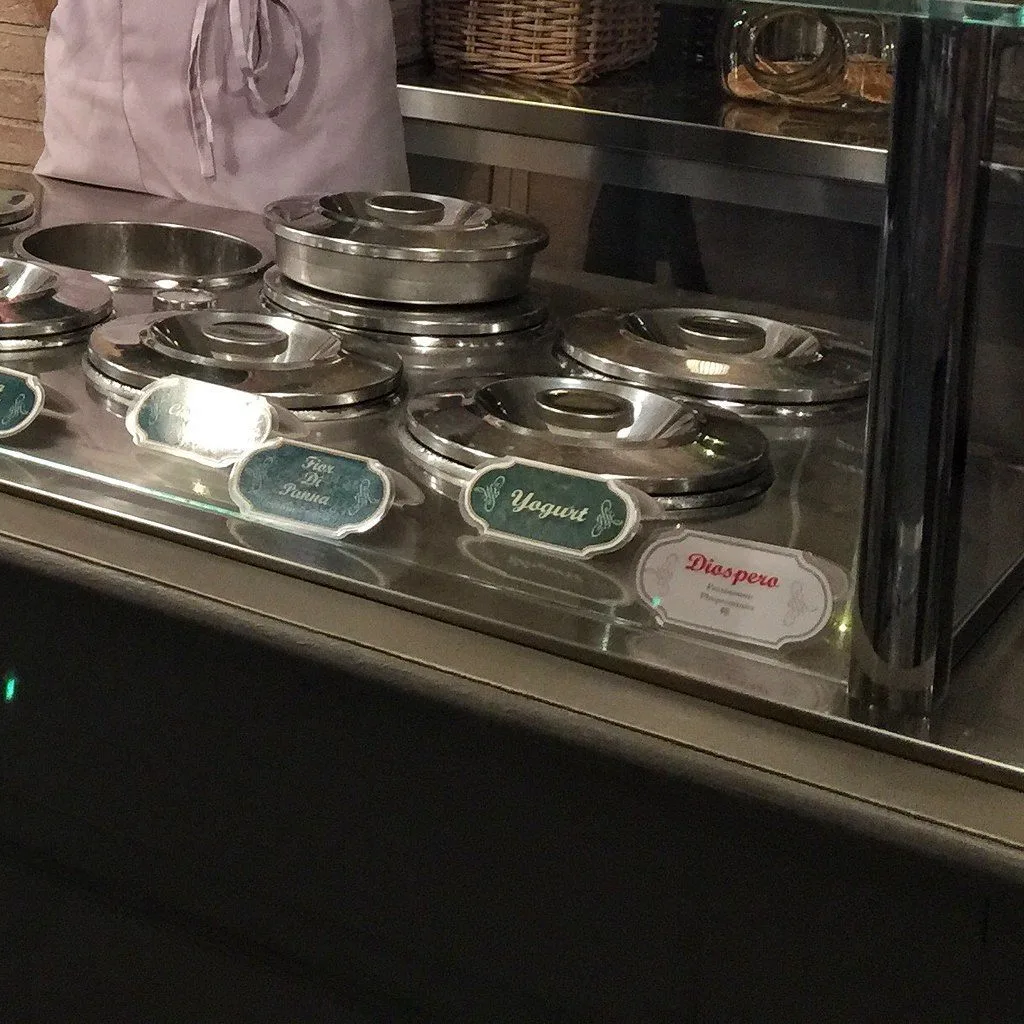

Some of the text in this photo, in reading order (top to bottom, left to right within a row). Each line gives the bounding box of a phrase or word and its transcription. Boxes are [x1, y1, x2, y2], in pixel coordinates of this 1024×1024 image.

[278, 482, 331, 506] Panna
[510, 489, 590, 523] Yogurt
[684, 552, 780, 589] Diospero
